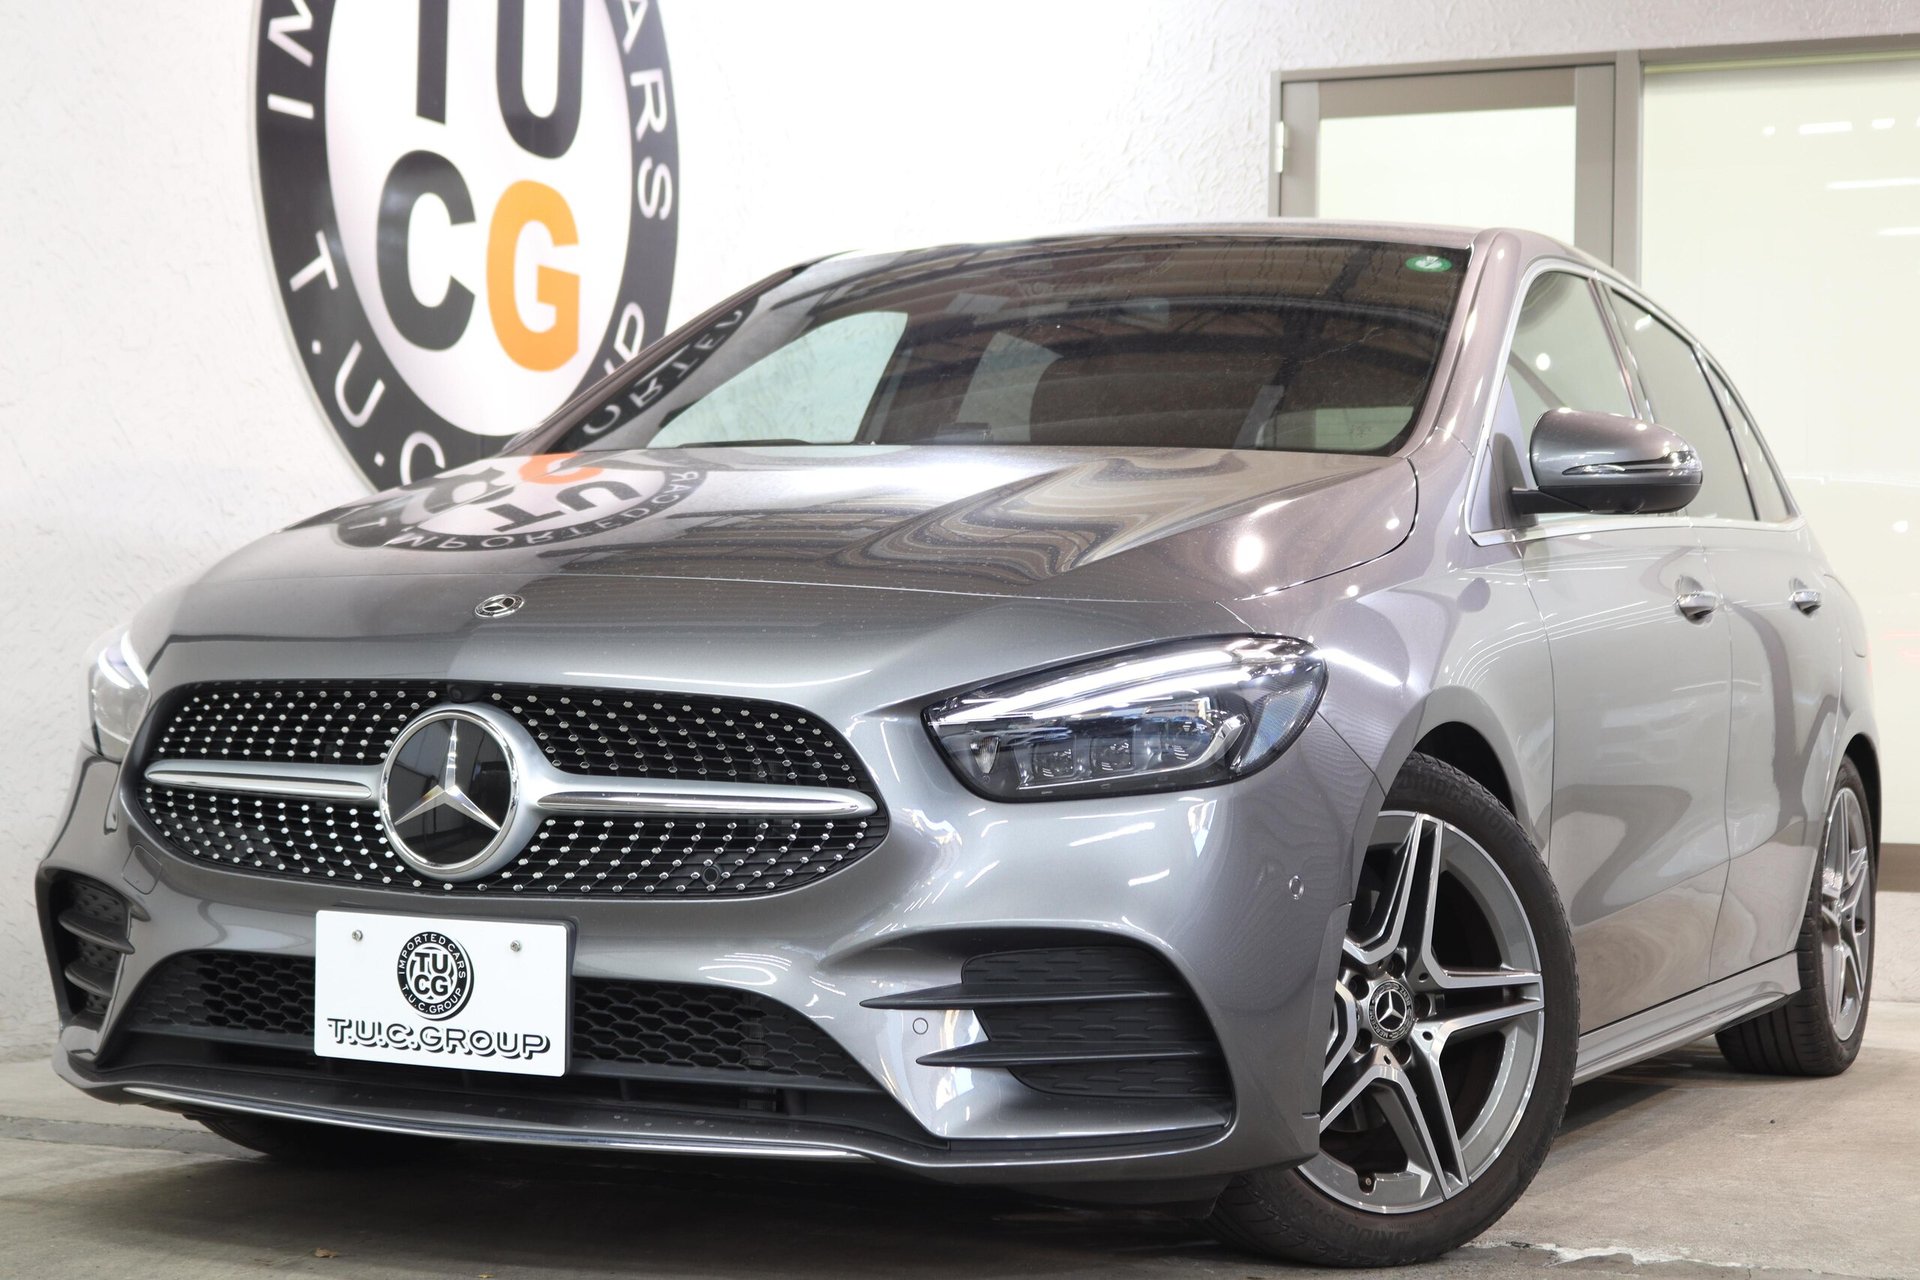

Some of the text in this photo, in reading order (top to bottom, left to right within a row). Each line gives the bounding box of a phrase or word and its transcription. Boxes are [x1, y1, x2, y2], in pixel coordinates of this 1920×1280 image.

[622, 0, 673, 220] ARS
[377, 150, 580, 372] CG
[399, 934, 466, 978] IMPORTED CARS
[414, 952, 448, 974] TU
[414, 974, 448, 996] CG
[327, 1018, 551, 1059] T.U.C.GROUP
